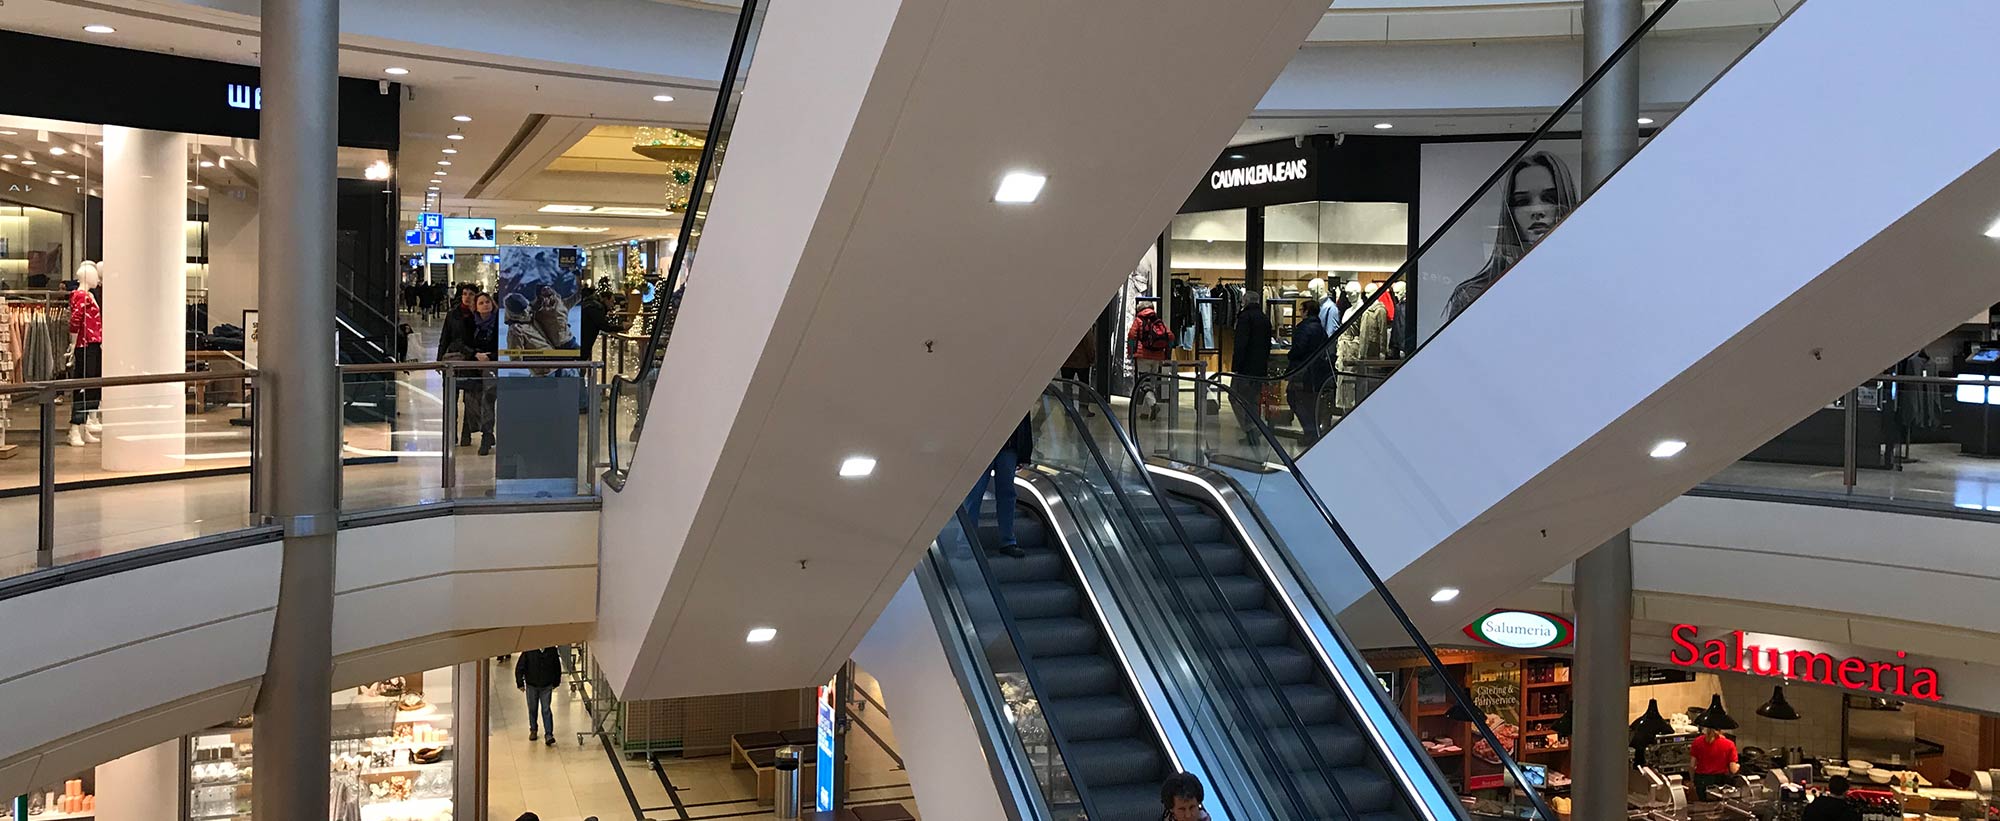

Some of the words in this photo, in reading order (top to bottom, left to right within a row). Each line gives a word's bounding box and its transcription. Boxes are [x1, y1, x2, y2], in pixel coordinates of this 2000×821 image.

[1211, 168, 1245, 190] CALVIN
[1245, 164, 1273, 185] KLEIN
[1272, 159, 1307, 182] JEANS
[1485, 620, 1552, 637] Salumeria
[1670, 623, 1942, 701] Salumeria
[1477, 685, 1507, 696] Catering
[1507, 684, 1514, 694] &
[1473, 696, 1516, 707] Partyservice
